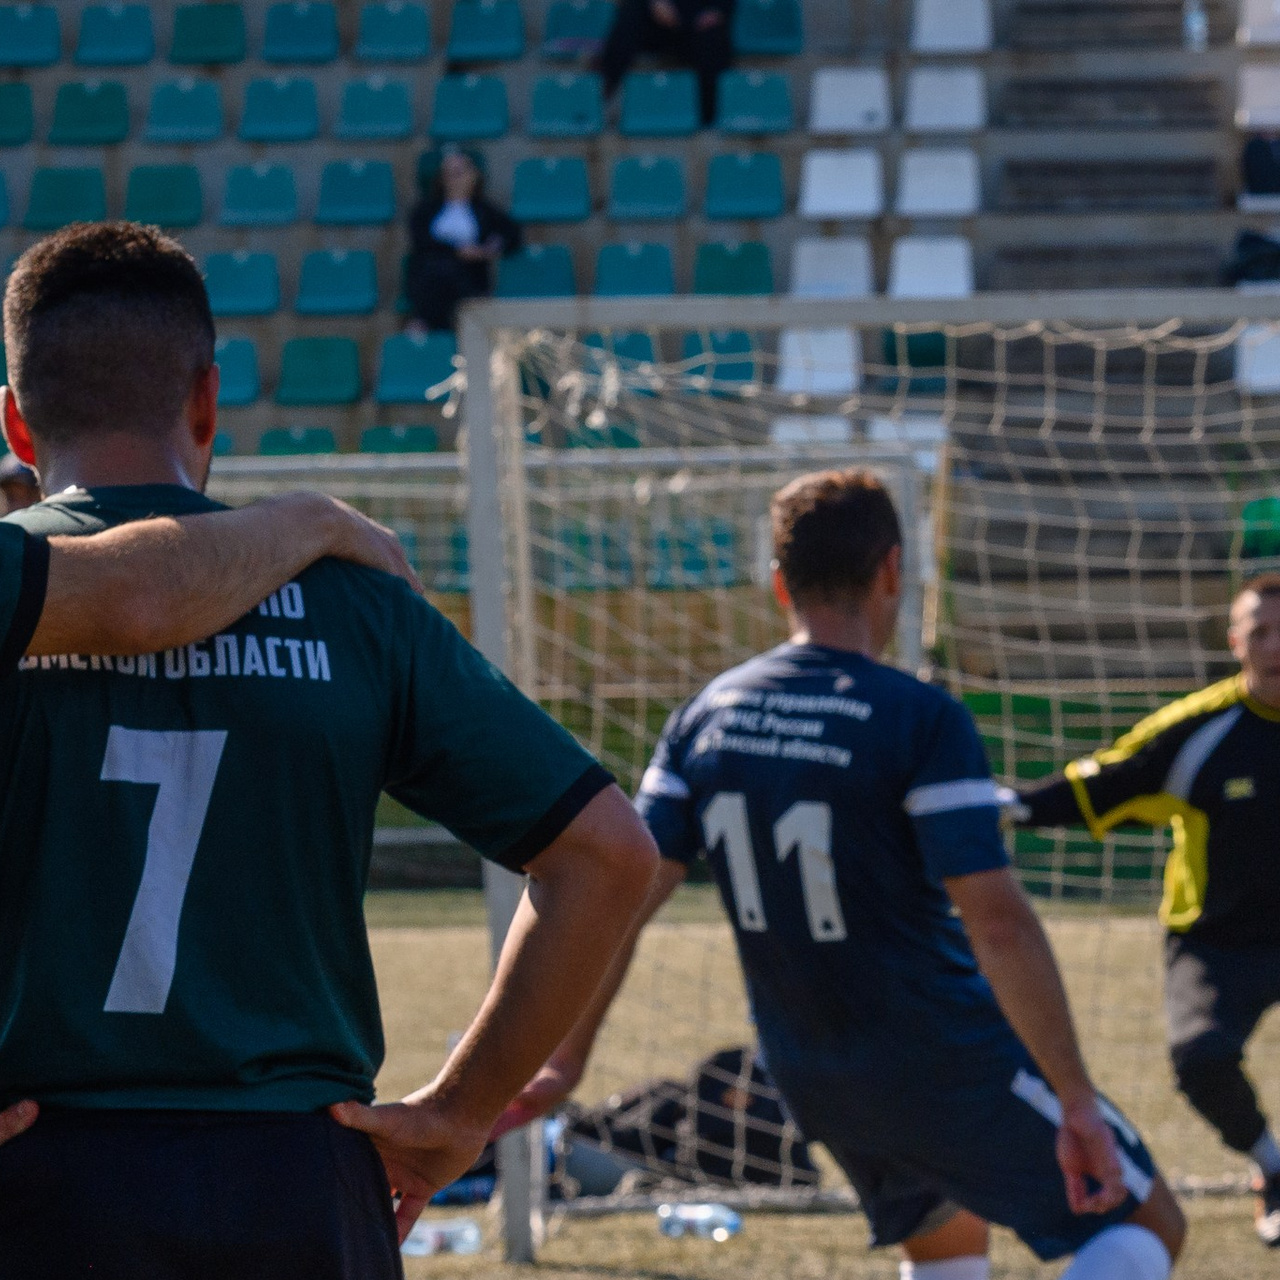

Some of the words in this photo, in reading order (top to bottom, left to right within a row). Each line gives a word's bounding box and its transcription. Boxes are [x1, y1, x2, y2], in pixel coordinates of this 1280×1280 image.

[163, 634, 332, 681] ОБЛАСТИ
[100, 725, 228, 1014] 7
[701, 791, 848, 942] 11
